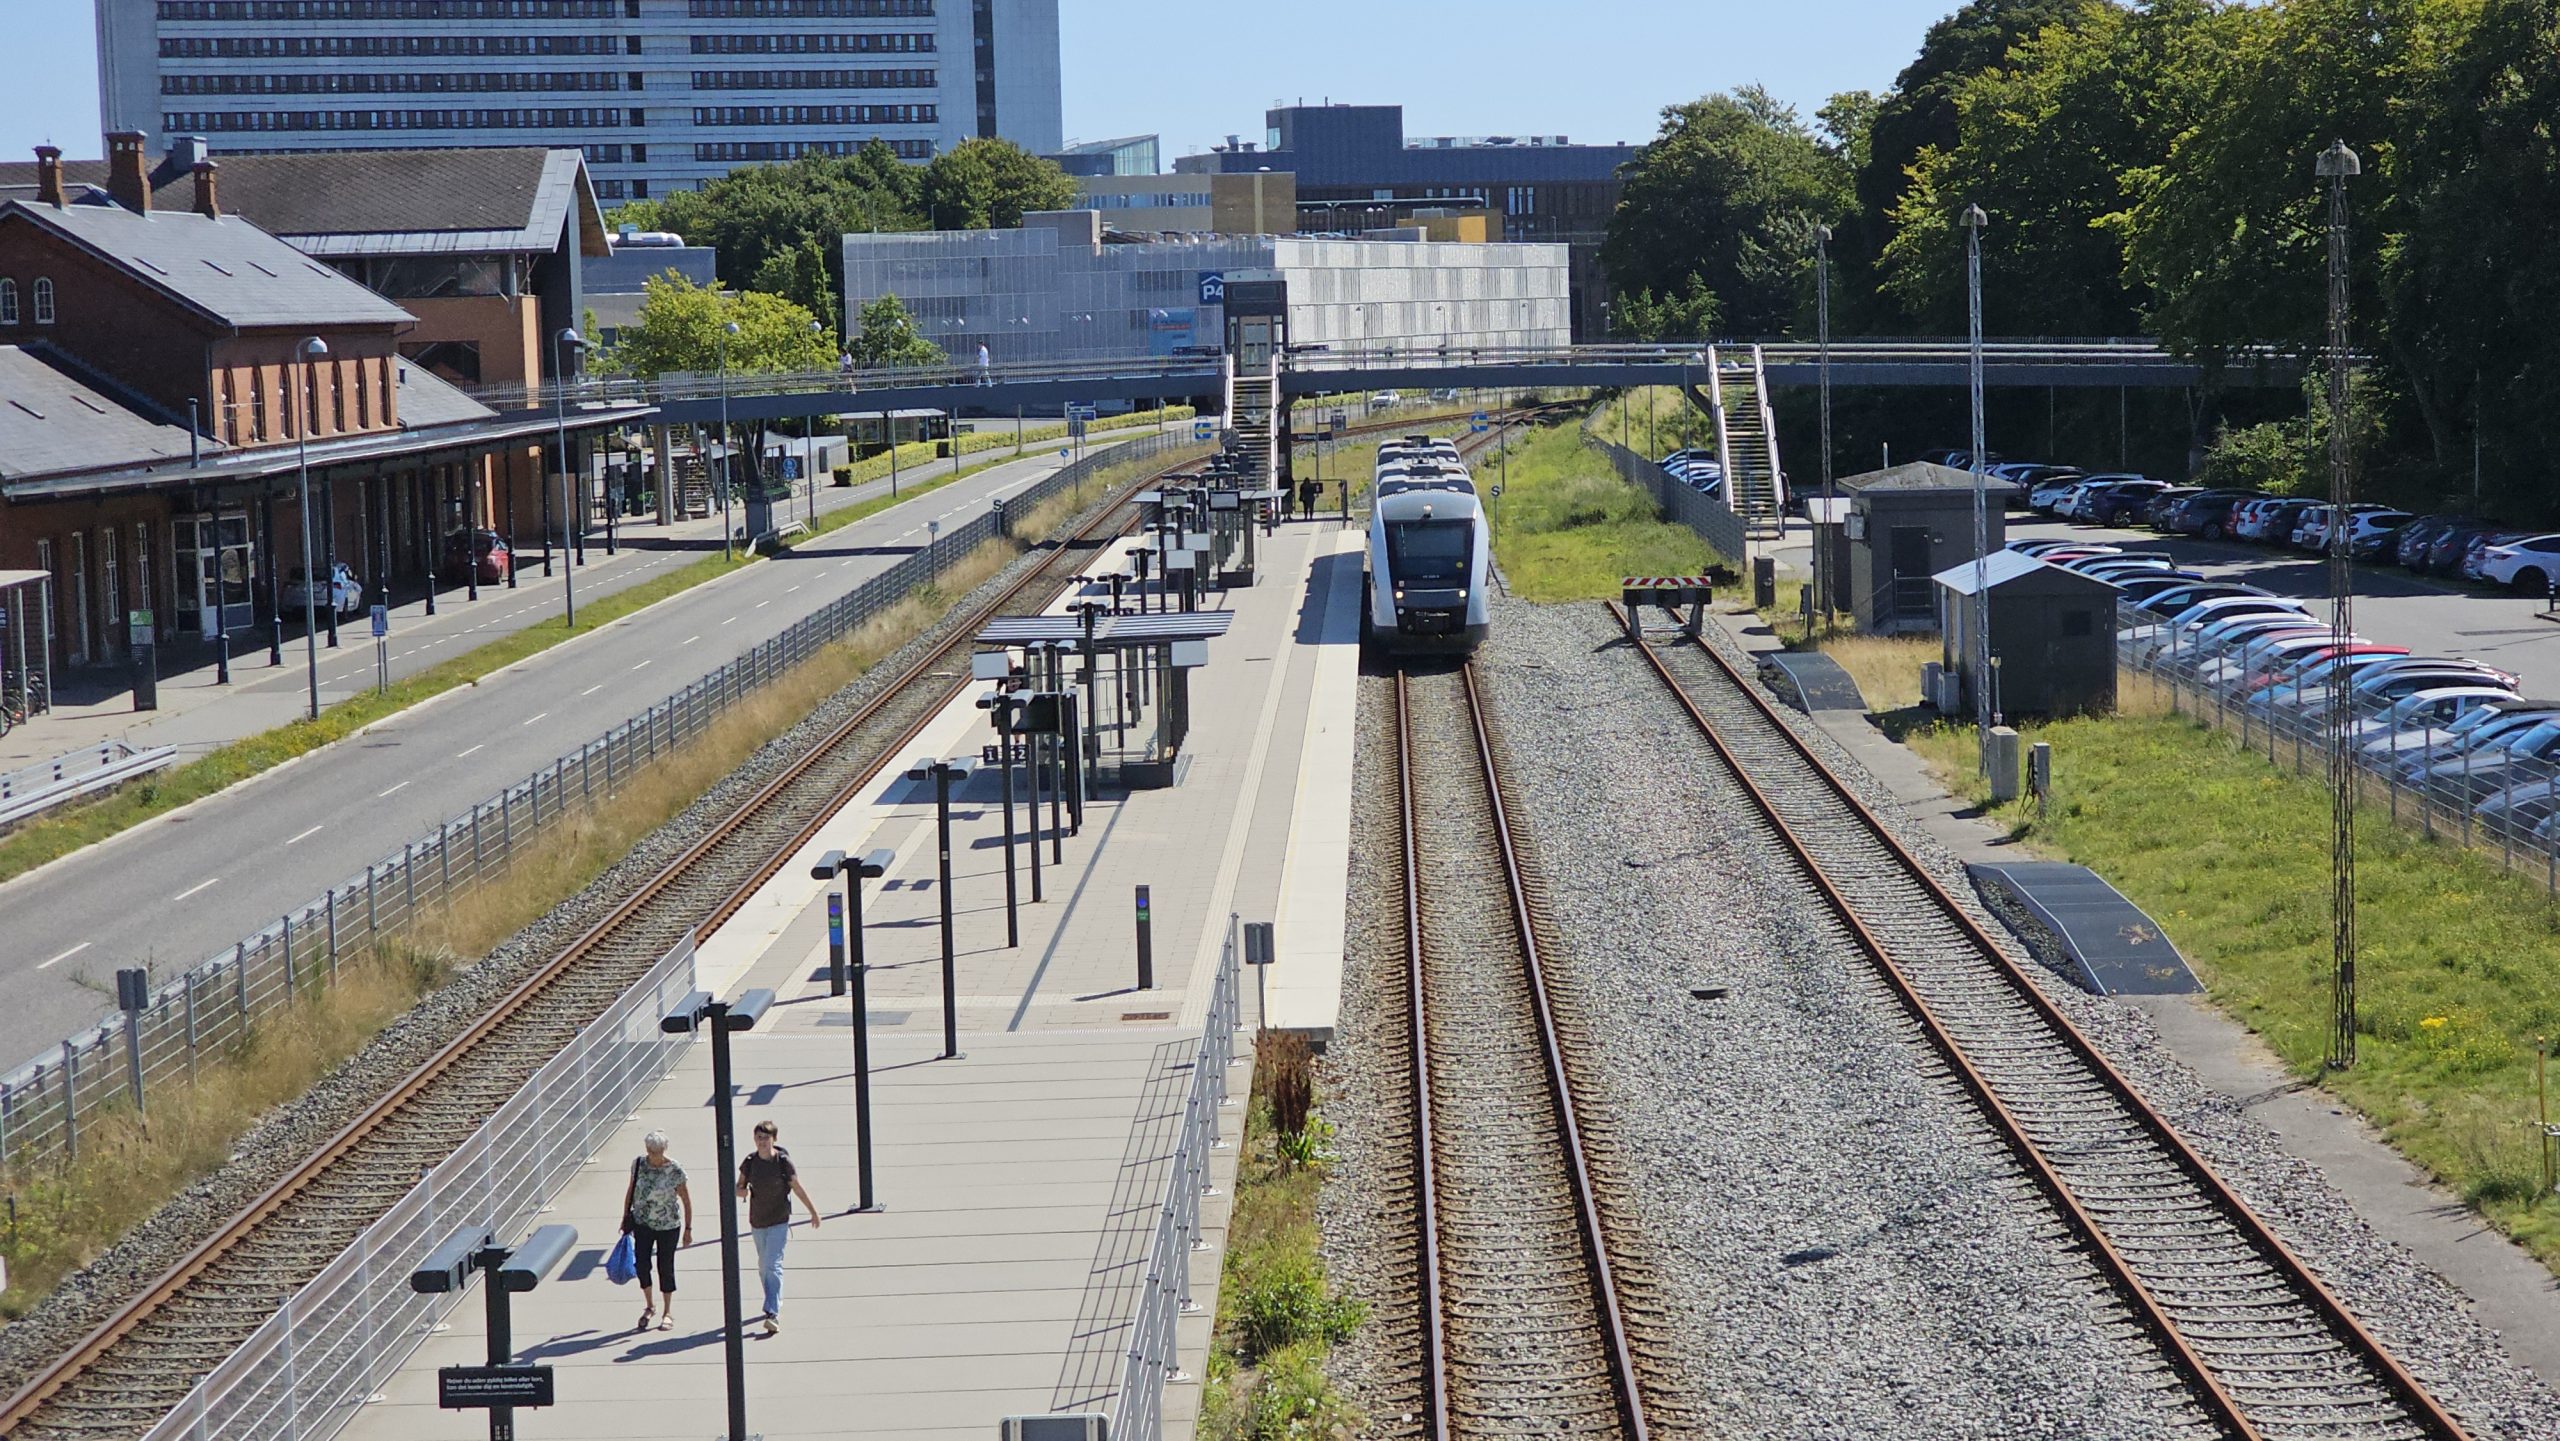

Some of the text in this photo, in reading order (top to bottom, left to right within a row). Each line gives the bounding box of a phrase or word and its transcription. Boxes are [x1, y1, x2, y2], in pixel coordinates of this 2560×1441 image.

[1203, 284, 1224, 300] P4
[1490, 485, 1500, 497] S
[993, 499, 1003, 511] S
[987, 749, 1026, 761] 1 2
